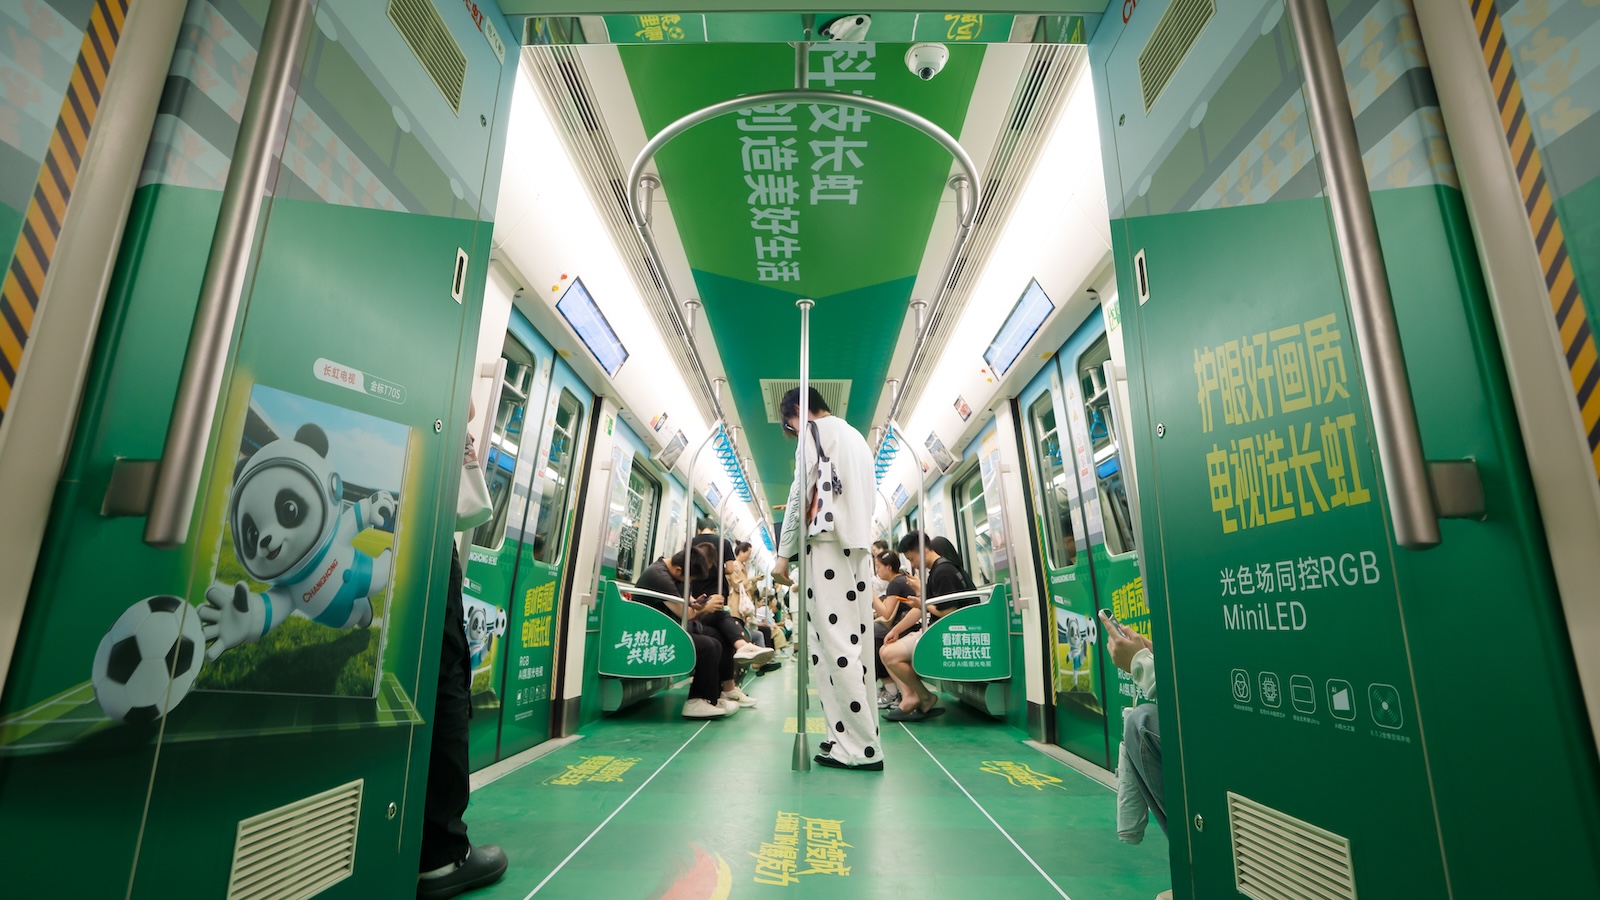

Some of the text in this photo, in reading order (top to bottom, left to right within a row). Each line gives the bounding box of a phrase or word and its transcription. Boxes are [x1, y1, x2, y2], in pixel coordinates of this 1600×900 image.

[807, 42, 877, 205] 科技长虹
[736, 95, 802, 281] 创造美好生活
[323, 364, 401, 400] 长虹电视 金标T70S
[1193, 312, 1351, 434] 护眼好画质
[1205, 413, 1371, 534] 电视选长虹
[302, 558, 339, 603] CHANGHONG
[1219, 550, 1381, 597] 光色场同控RGB
[1223, 601, 1307, 631] MiniLED
[614, 629, 667, 649] 与热AI
[626, 644, 676, 665] 共精彩
[942, 632, 991, 646] 看球有氛围
[942, 646, 992, 660] 电视选长虹
[942, 660, 956, 668] RGB
[790, 815, 855, 877] 把压力变成
